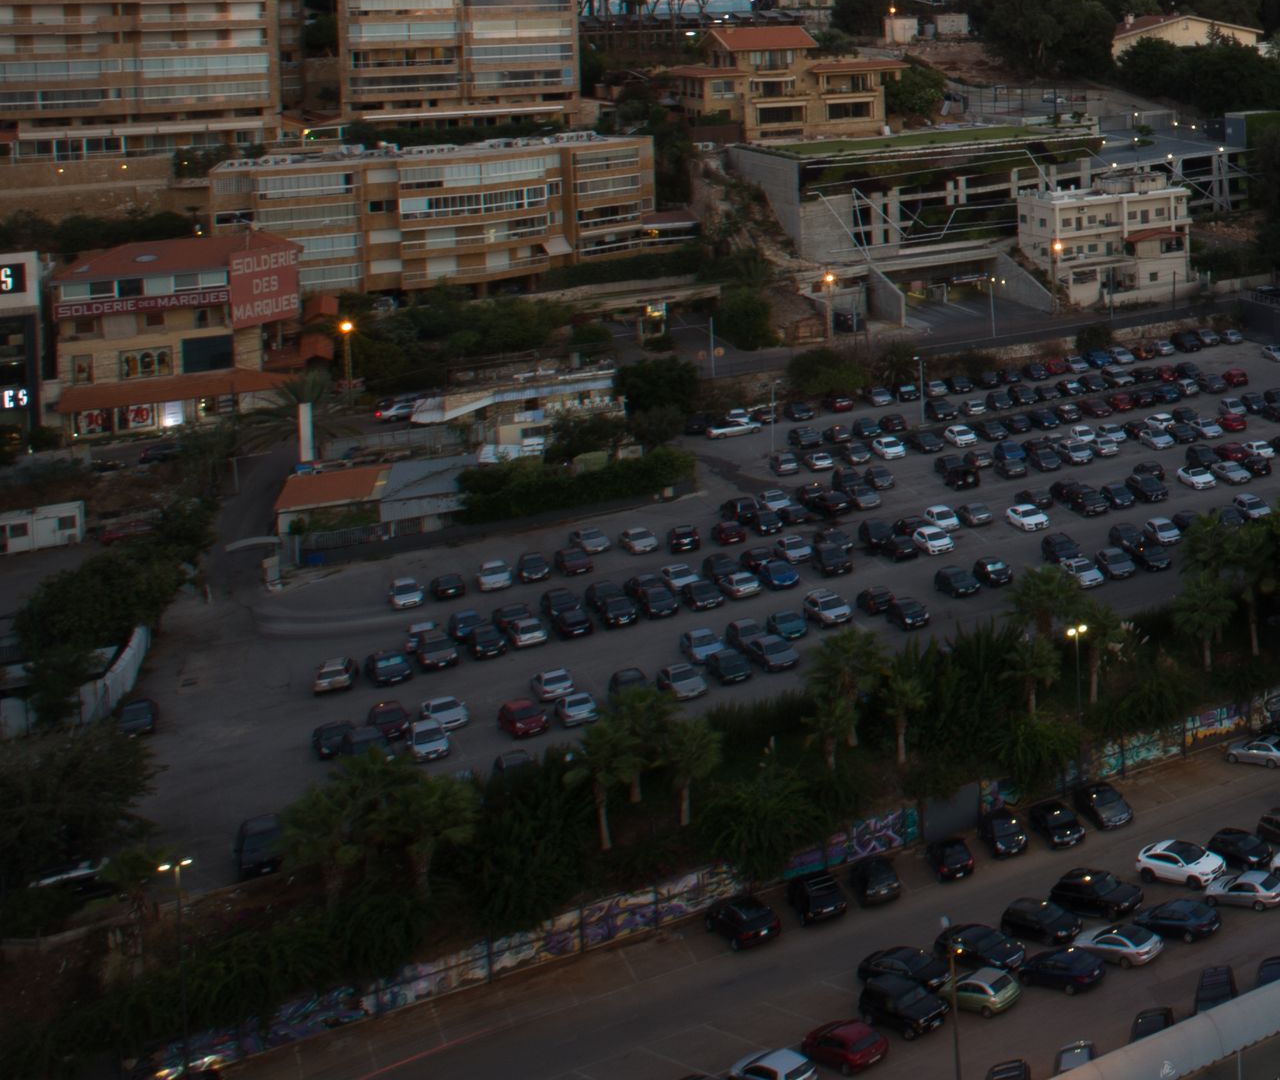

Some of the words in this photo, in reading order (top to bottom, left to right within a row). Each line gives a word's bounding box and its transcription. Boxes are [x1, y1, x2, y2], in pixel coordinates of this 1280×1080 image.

[231, 249, 298, 276] SOLDERIE
[253, 275, 279, 295] DES
[57, 299, 137, 318] SOLDERIE
[157, 291, 229, 309] MARQUES
[233, 293, 300, 322] MARQUES
